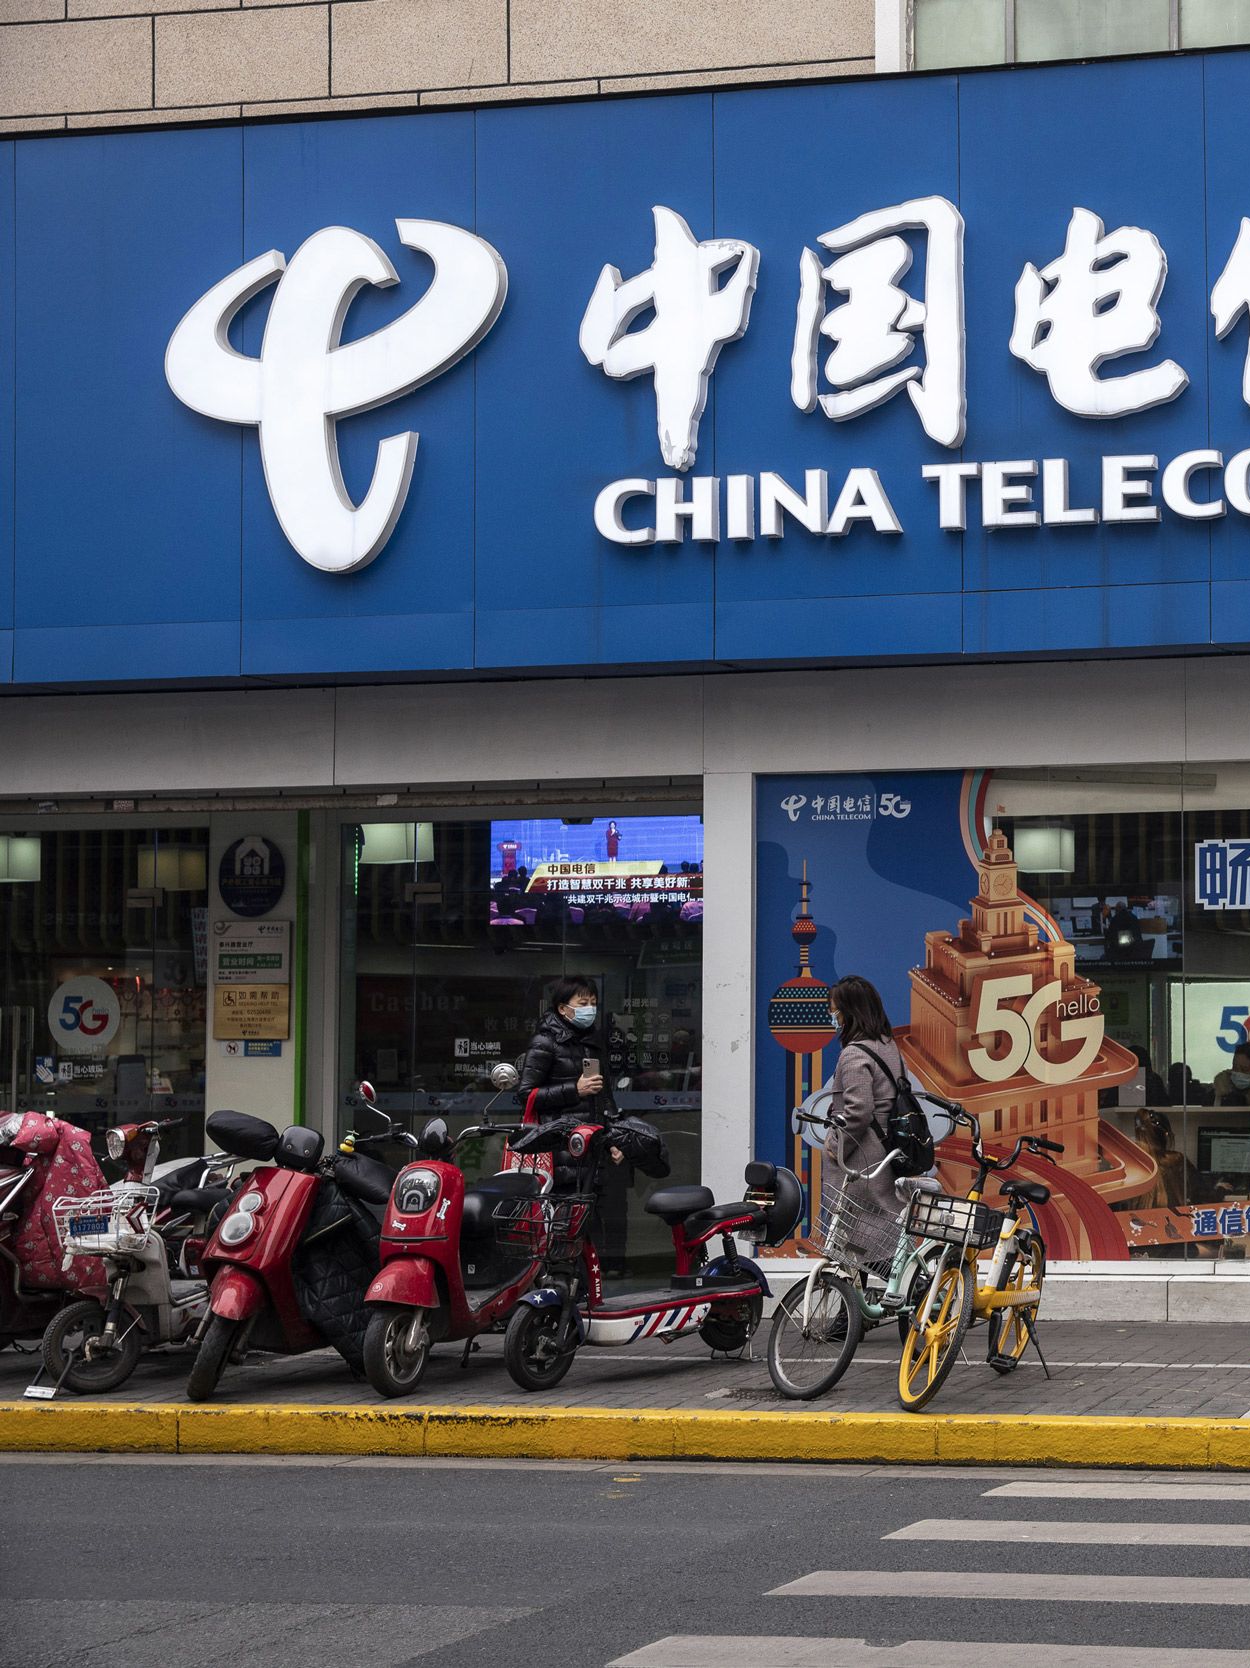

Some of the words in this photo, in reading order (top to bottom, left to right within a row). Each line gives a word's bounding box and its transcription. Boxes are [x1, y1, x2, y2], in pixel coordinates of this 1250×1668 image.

[594, 465, 903, 546] CHINA
[811, 795, 871, 814] 中国电信
[879, 794, 912, 818] 5G
[547, 863, 596, 875] 中国电信
[547, 879, 626, 891] 打造智慧双千兆
[59, 996, 109, 1036] 5G
[968, 973, 1105, 1085] 5G
[1056, 994, 1100, 1018] hello
[471, 1042, 501, 1051] 当心玻璃
